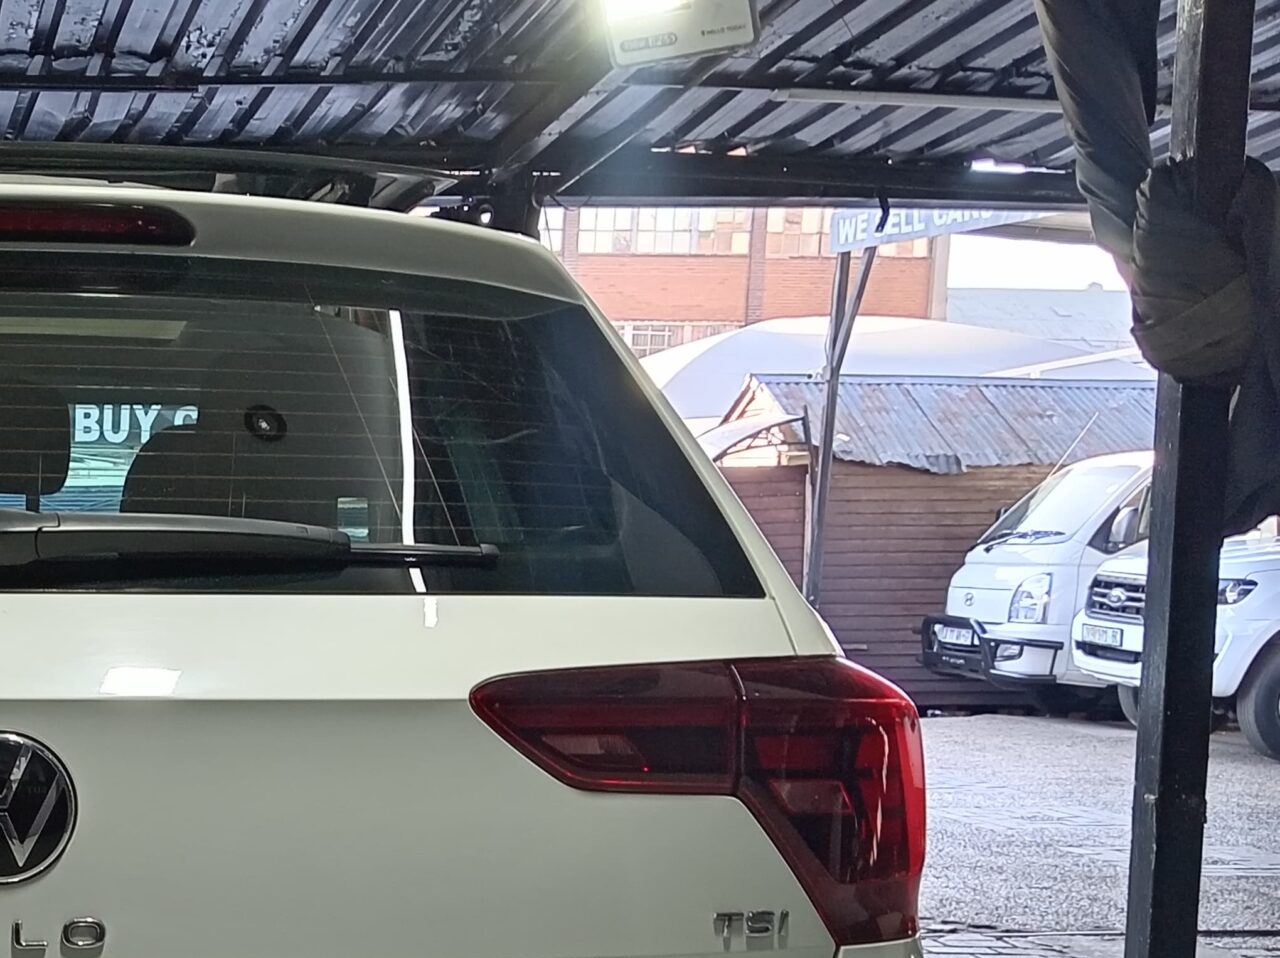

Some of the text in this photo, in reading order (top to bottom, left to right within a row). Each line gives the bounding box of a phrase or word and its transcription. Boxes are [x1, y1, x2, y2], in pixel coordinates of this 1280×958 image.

[838, 212, 868, 245] WE
[75, 404, 162, 443] BUY
[713, 910, 789, 938] TSI
